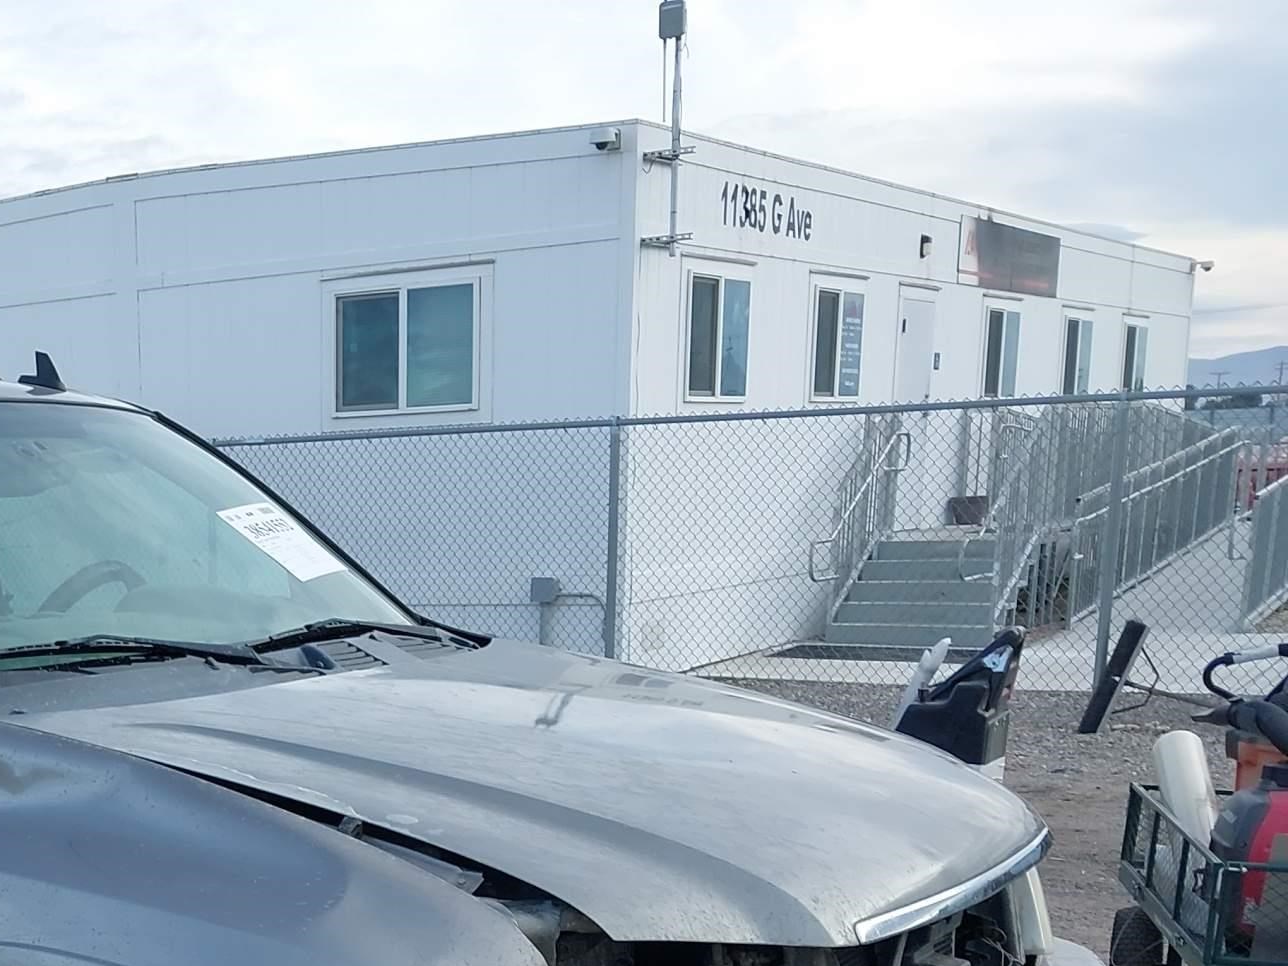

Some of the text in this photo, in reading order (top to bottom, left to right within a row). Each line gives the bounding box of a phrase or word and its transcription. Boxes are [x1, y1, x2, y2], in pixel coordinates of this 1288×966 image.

[721, 180, 813, 242] 11385 G Ave
